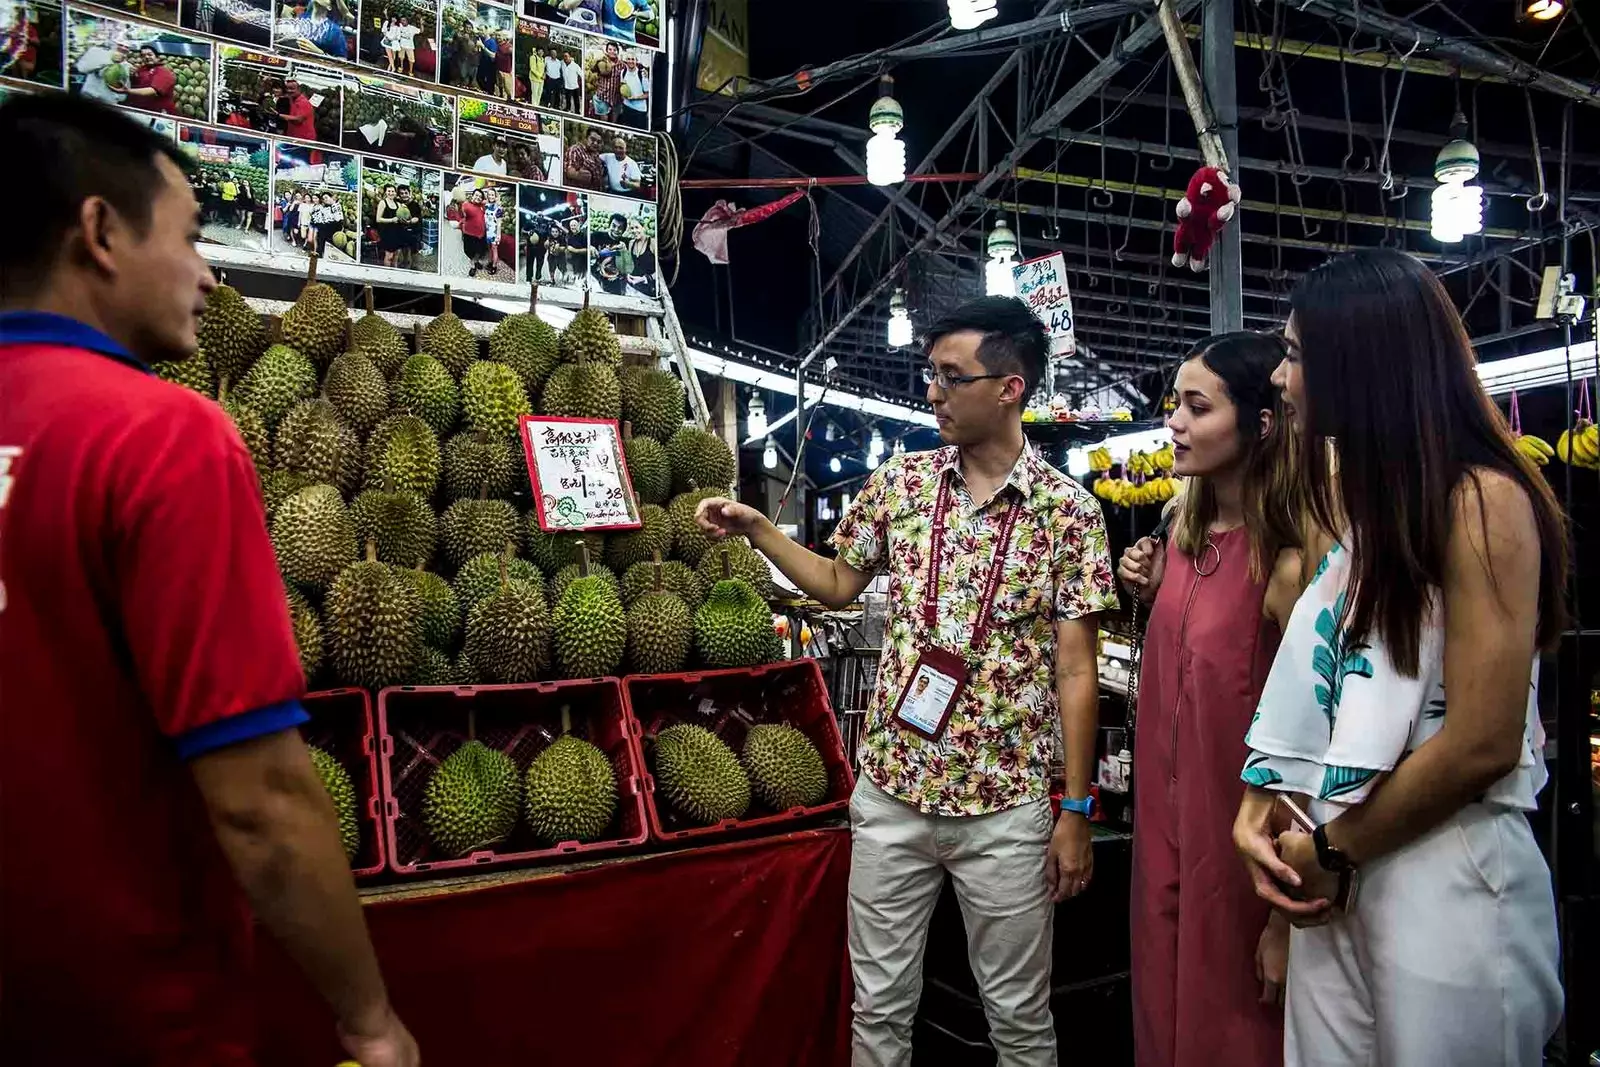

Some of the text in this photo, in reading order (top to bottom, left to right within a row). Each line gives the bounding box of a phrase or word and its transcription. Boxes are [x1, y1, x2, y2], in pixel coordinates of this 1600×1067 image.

[519, 122, 532, 130] D24
[1050, 309, 1072, 333] 48
[606, 488, 623, 499] 38
